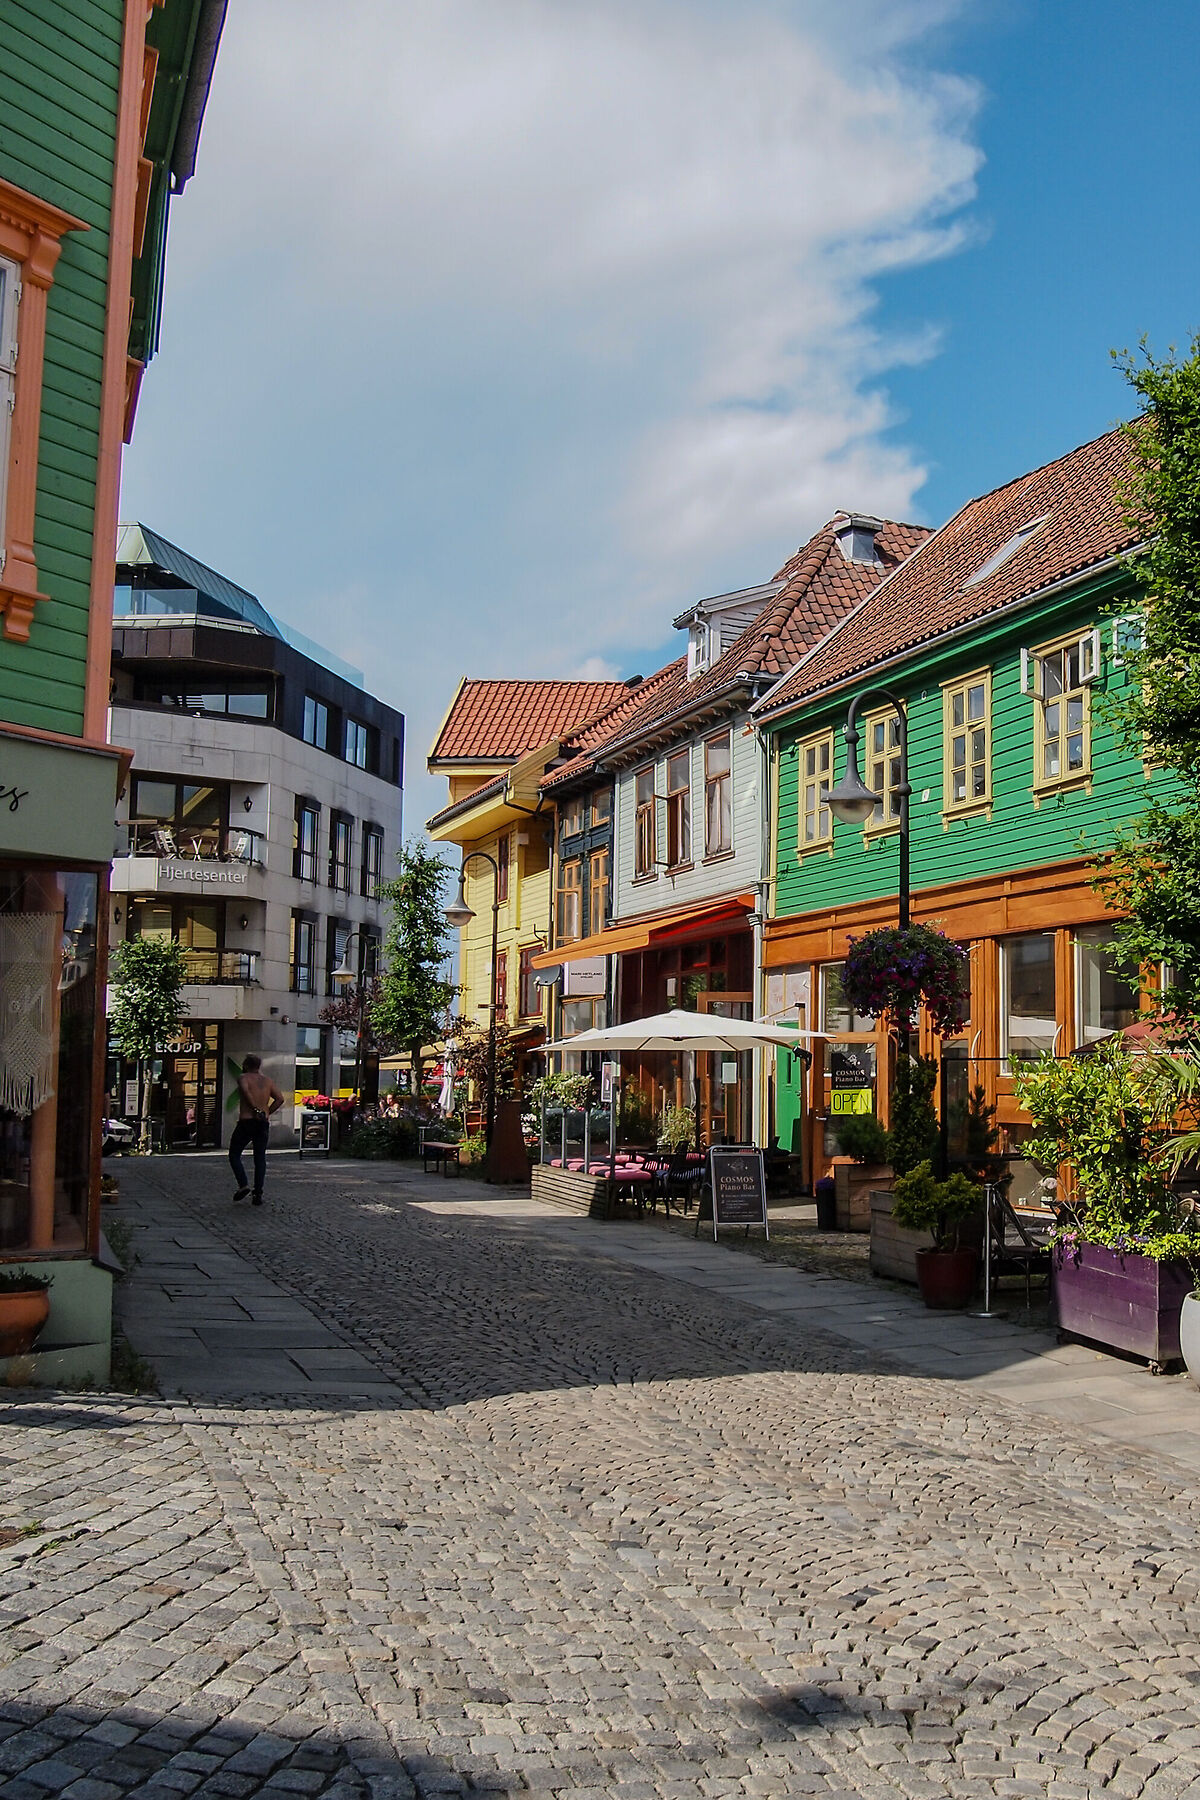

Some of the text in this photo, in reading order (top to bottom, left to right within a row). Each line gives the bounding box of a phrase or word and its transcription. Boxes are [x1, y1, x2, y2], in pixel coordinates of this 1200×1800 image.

[159, 865, 247, 883] Hjertesenter
[833, 1093, 869, 1112] OPEN
[720, 1176, 754, 1184] COSMOS
[720, 1183, 741, 1191] Piano
